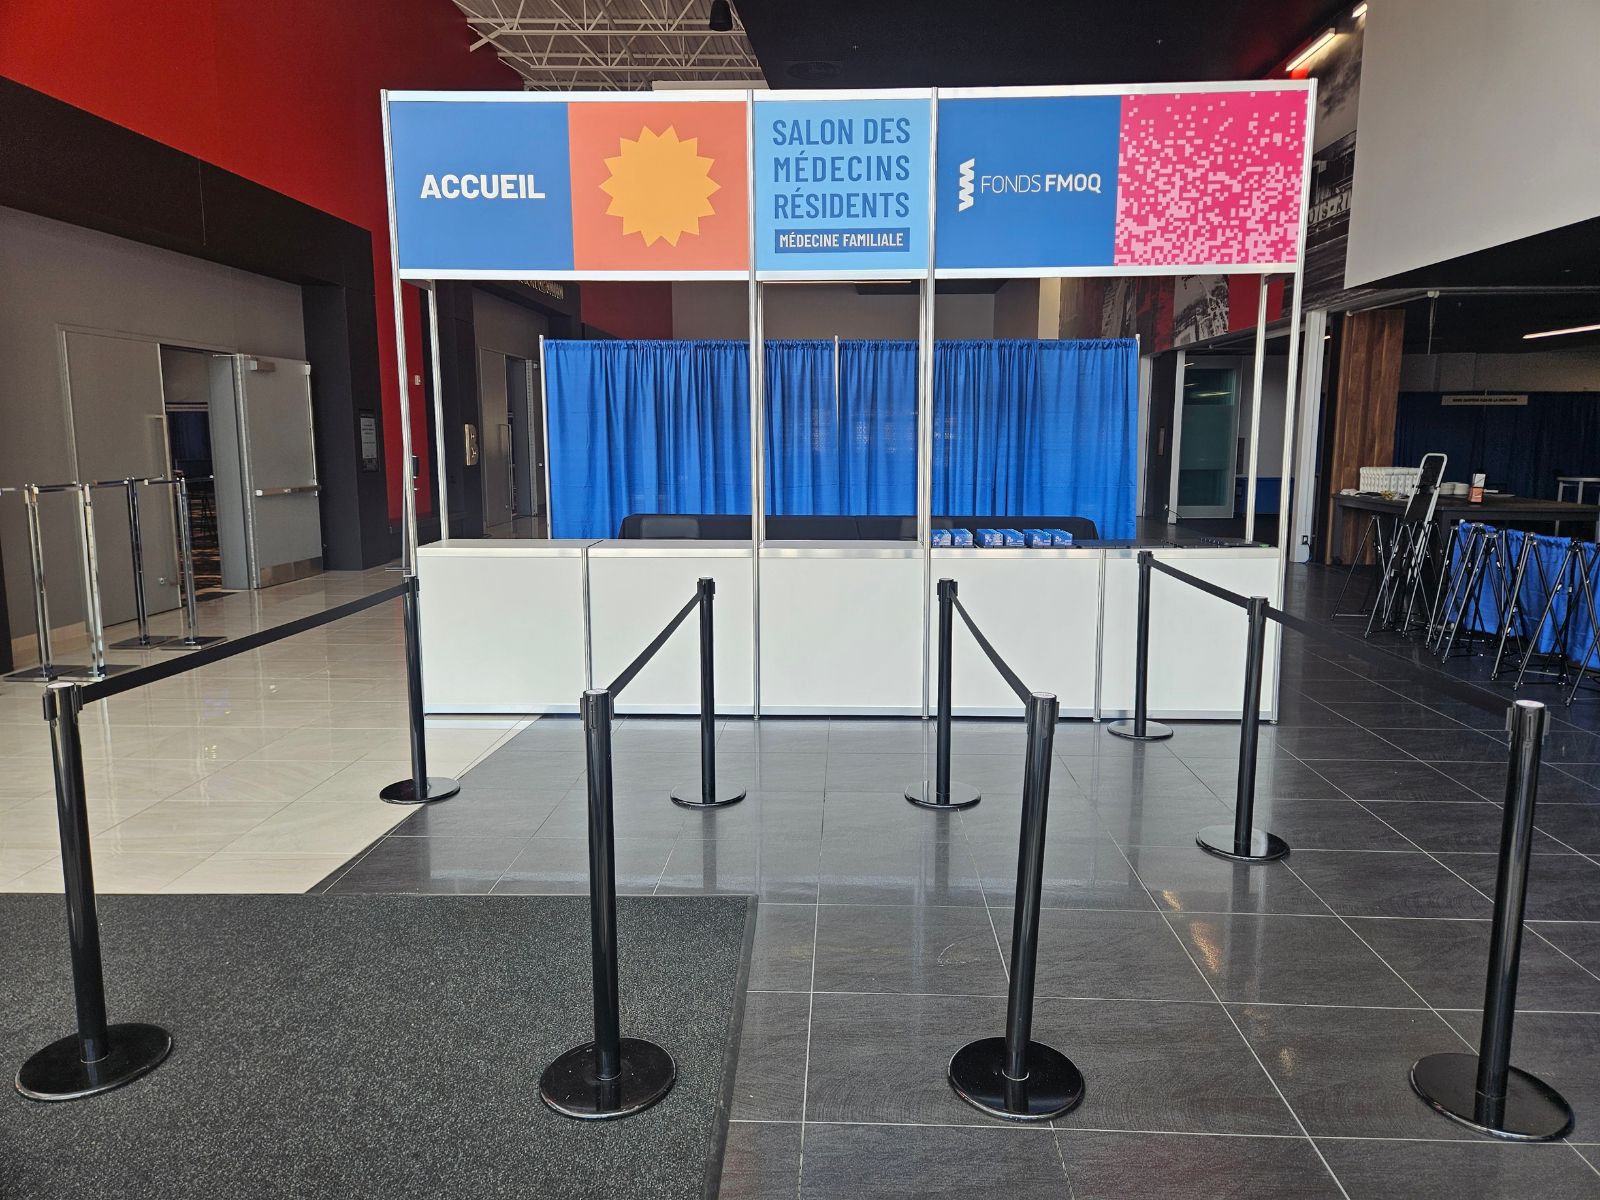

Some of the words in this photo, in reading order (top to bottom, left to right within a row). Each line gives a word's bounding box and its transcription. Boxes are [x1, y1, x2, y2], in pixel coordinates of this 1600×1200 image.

[772, 119, 853, 146] SALON
[863, 118, 911, 145] DES
[773, 150, 910, 182] MÉDECINS
[420, 174, 546, 199] ACCUEIL
[981, 174, 1041, 194] FONDS
[1045, 173, 1102, 194] FMOQ
[774, 187, 910, 219] RÉSIDENTS
[779, 231, 840, 248] MÉDECINE
[843, 232, 904, 247] FAMILIALE
